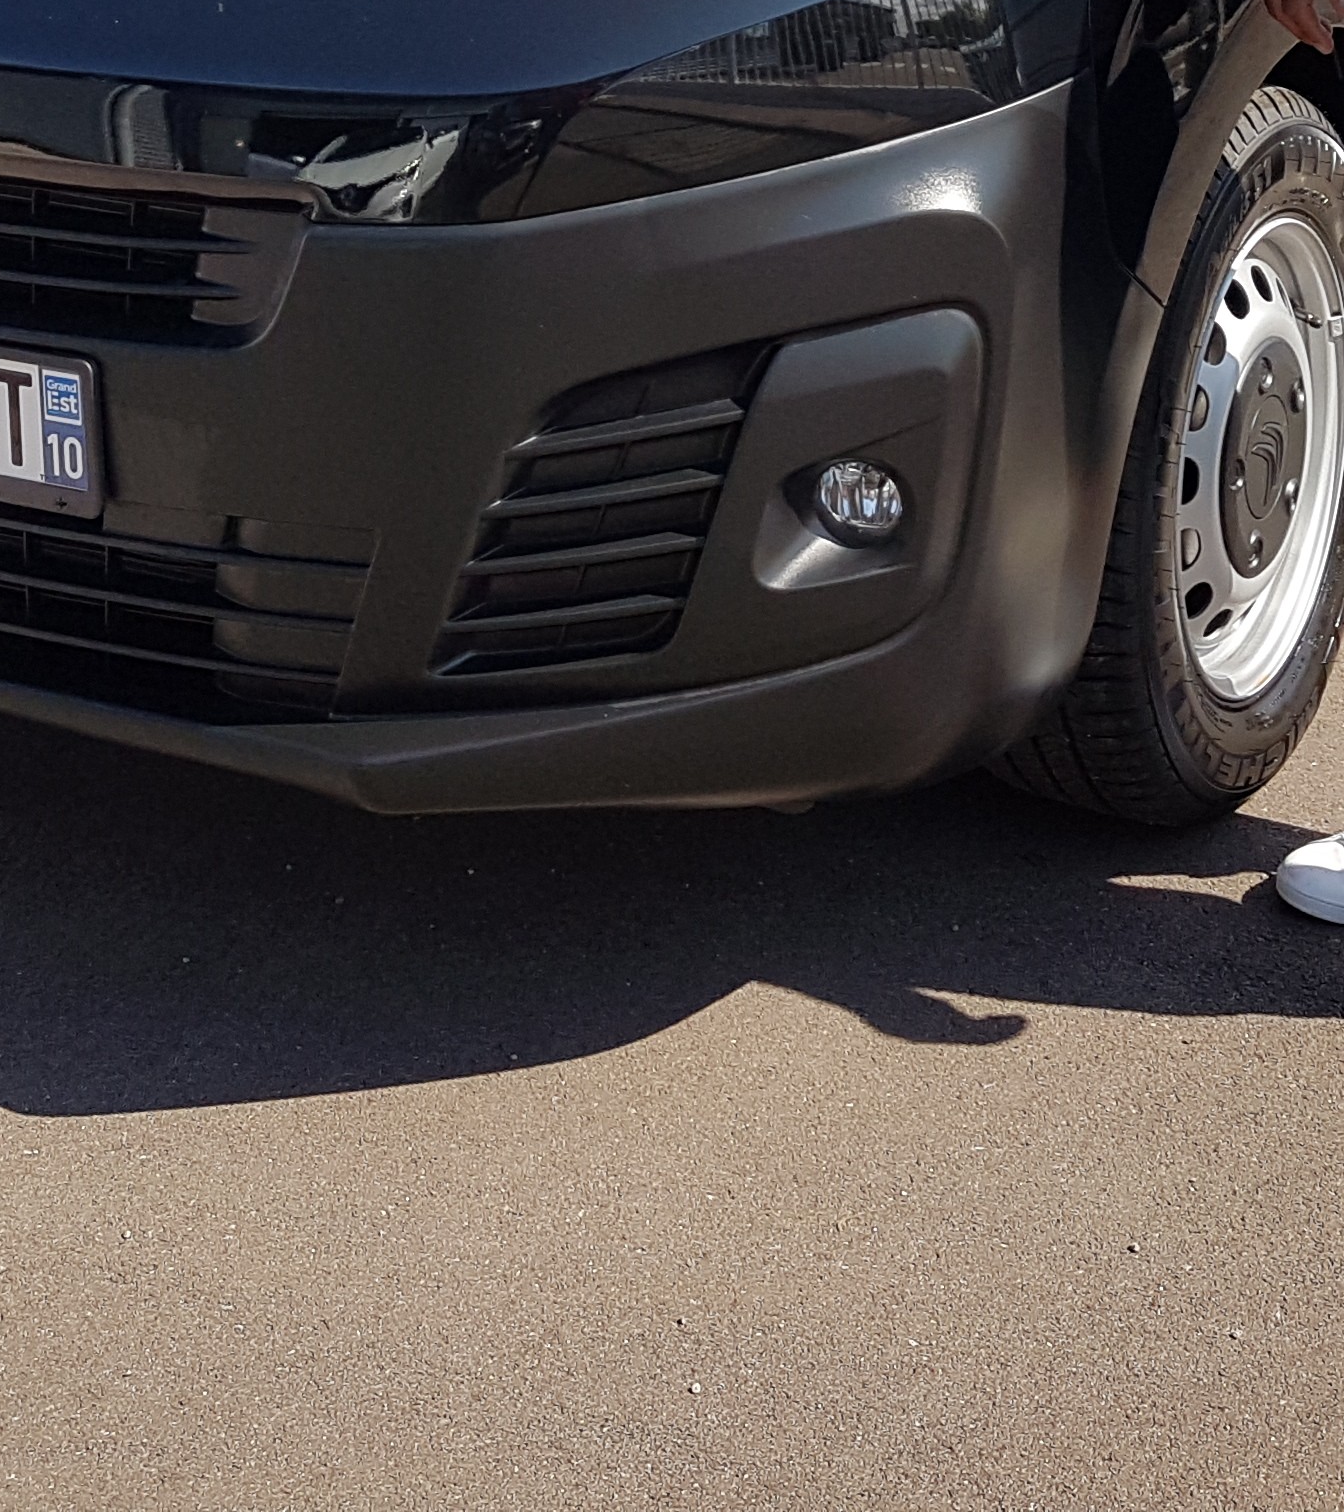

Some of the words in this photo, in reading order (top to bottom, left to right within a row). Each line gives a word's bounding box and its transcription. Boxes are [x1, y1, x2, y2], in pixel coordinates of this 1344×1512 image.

[46, 379, 77, 393] Grand
[46, 390, 78, 415] Est
[47, 433, 83, 480] 10
